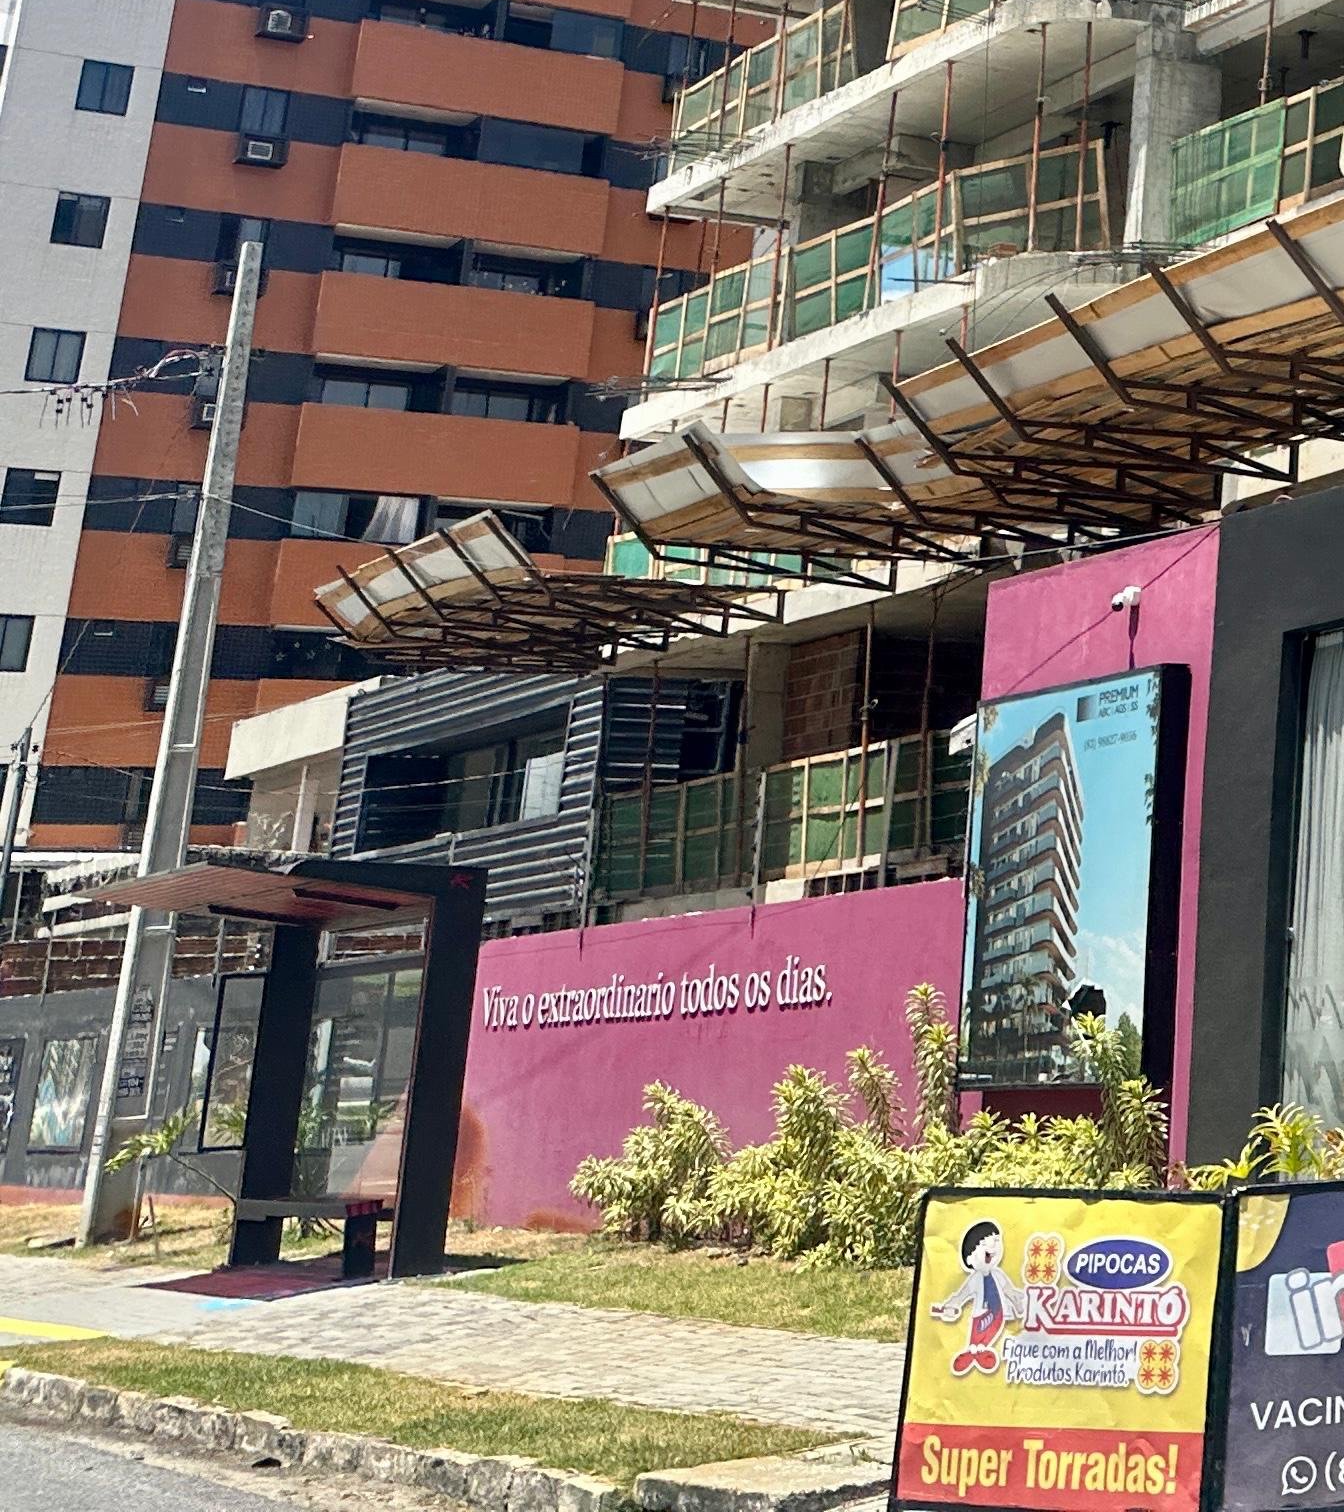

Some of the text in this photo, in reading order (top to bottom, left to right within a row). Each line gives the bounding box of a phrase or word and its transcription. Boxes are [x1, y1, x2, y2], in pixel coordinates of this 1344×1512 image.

[1099, 684, 1139, 705] PREMIUM
[483, 986, 518, 1028] Viva
[522, 993, 533, 1025] o
[680, 964, 740, 1016] todos
[744, 970, 771, 1008] os
[776, 954, 833, 1006] dias.
[1075, 1253, 1161, 1275] PIPOCAS
[1002, 1338, 1137, 1363] Fique com a Melhor!
[1007, 1360, 1072, 1382] Produtos
[921, 1435, 1179, 1497] Super Torradas!
